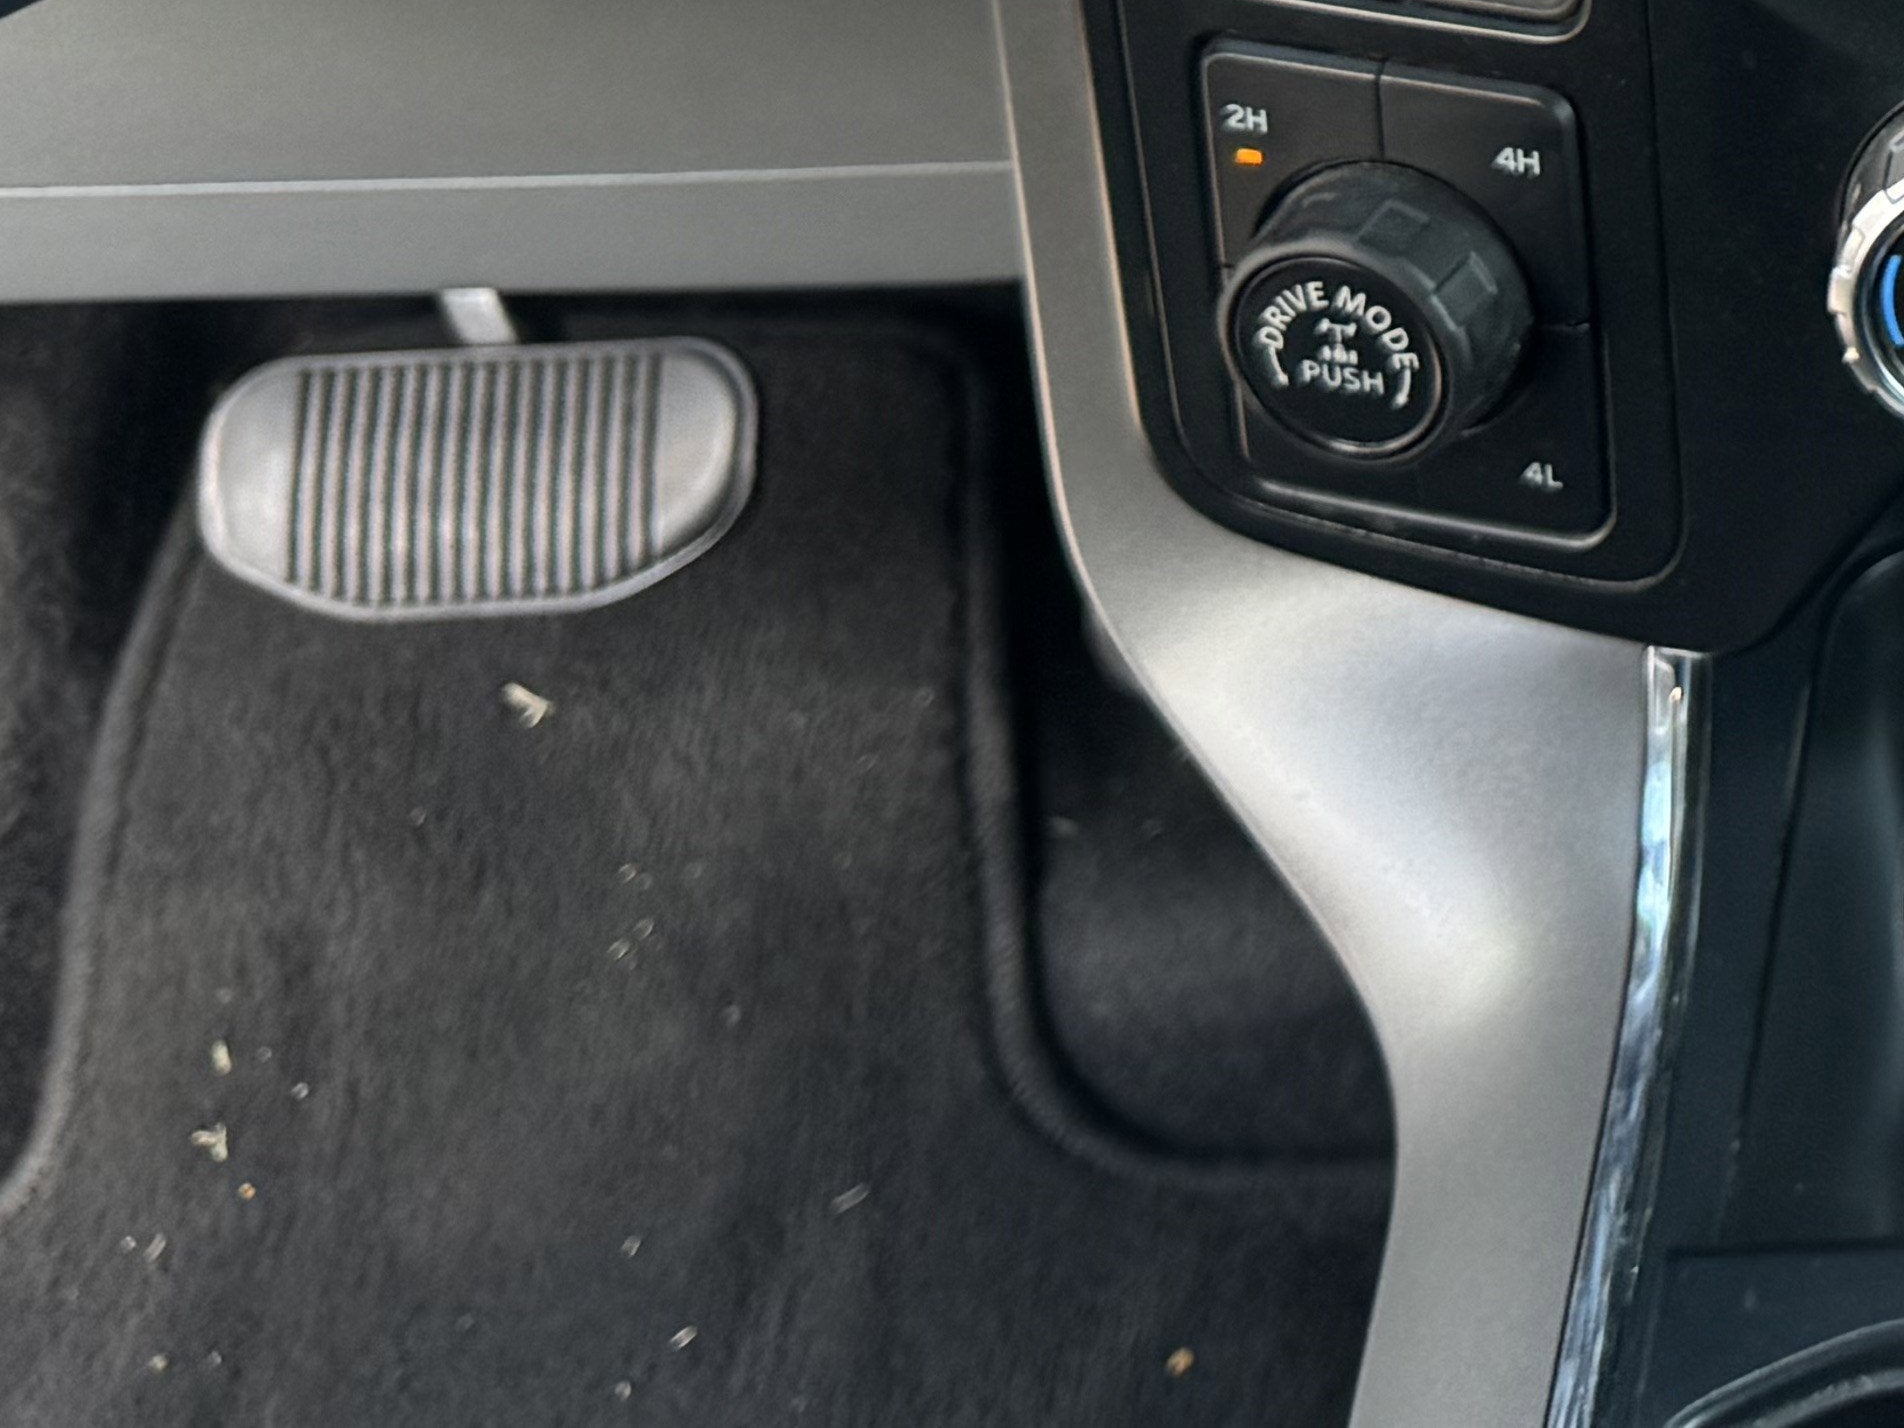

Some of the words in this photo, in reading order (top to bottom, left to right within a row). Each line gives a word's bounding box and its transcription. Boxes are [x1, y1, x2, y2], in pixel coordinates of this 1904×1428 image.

[1222, 103, 1270, 135] 2H
[1492, 147, 1541, 176] 4H
[1255, 281, 1328, 348] DRIVE
[1332, 285, 1419, 372] MODE
[1301, 361, 1384, 394] PUSH
[1521, 462, 1563, 491] 4L
